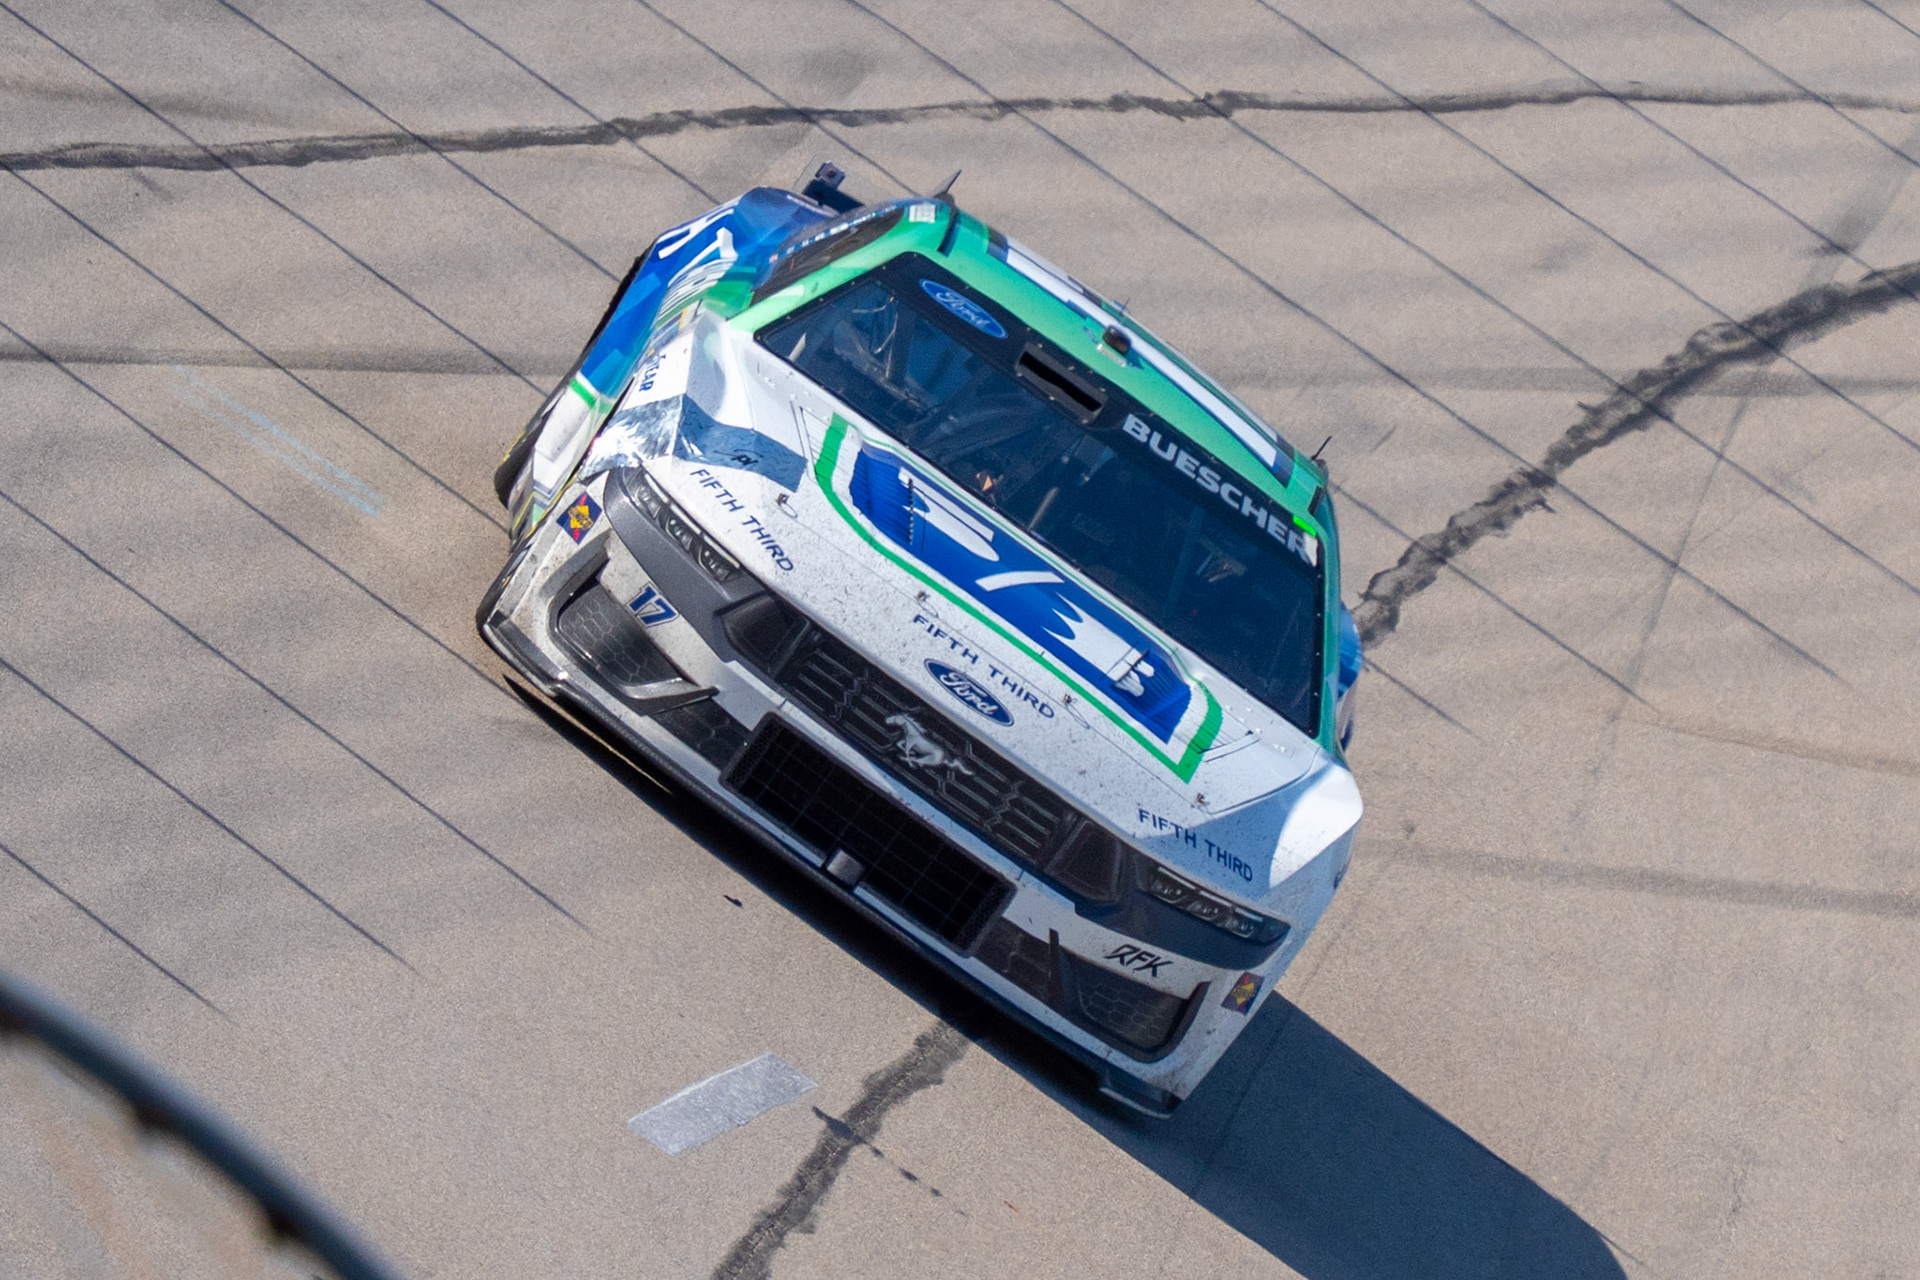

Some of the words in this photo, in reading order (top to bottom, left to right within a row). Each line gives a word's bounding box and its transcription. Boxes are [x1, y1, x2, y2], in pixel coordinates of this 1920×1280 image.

[689, 468, 744, 512] FIFTH
[742, 515, 794, 571] THIRD
[1122, 413, 1318, 567] BUESCHER
[625, 579, 681, 628] 17
[912, 614, 979, 664] FIFTH
[988, 663, 1055, 709] THIRD
[1138, 808, 1197, 848] FIFTH
[1204, 839, 1253, 882] THIRD
